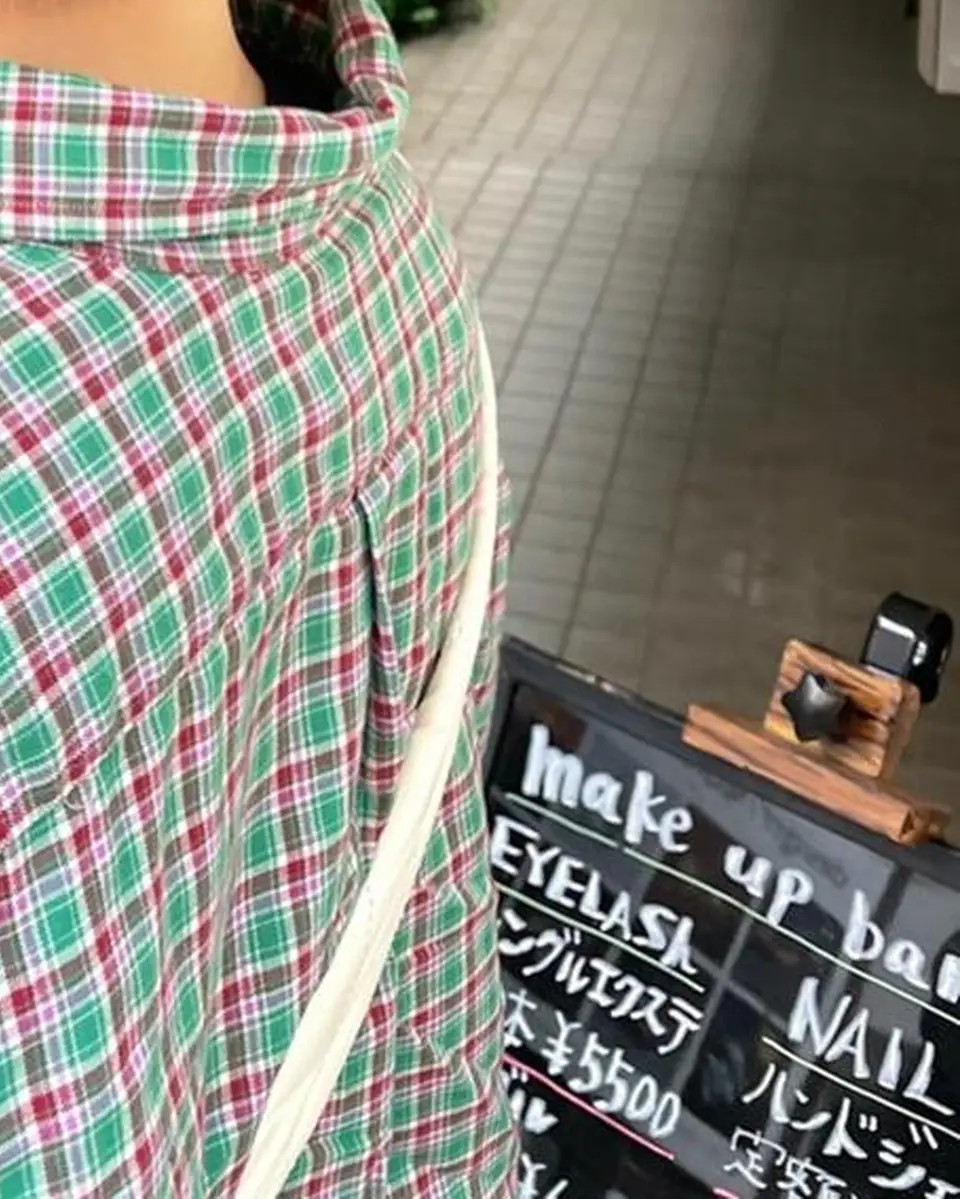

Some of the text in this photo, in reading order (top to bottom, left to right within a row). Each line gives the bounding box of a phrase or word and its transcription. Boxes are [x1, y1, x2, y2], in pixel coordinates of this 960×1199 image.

[521, 723, 694, 853] make
[723, 844, 815, 928] up
[788, 976, 956, 1116] NAIL
